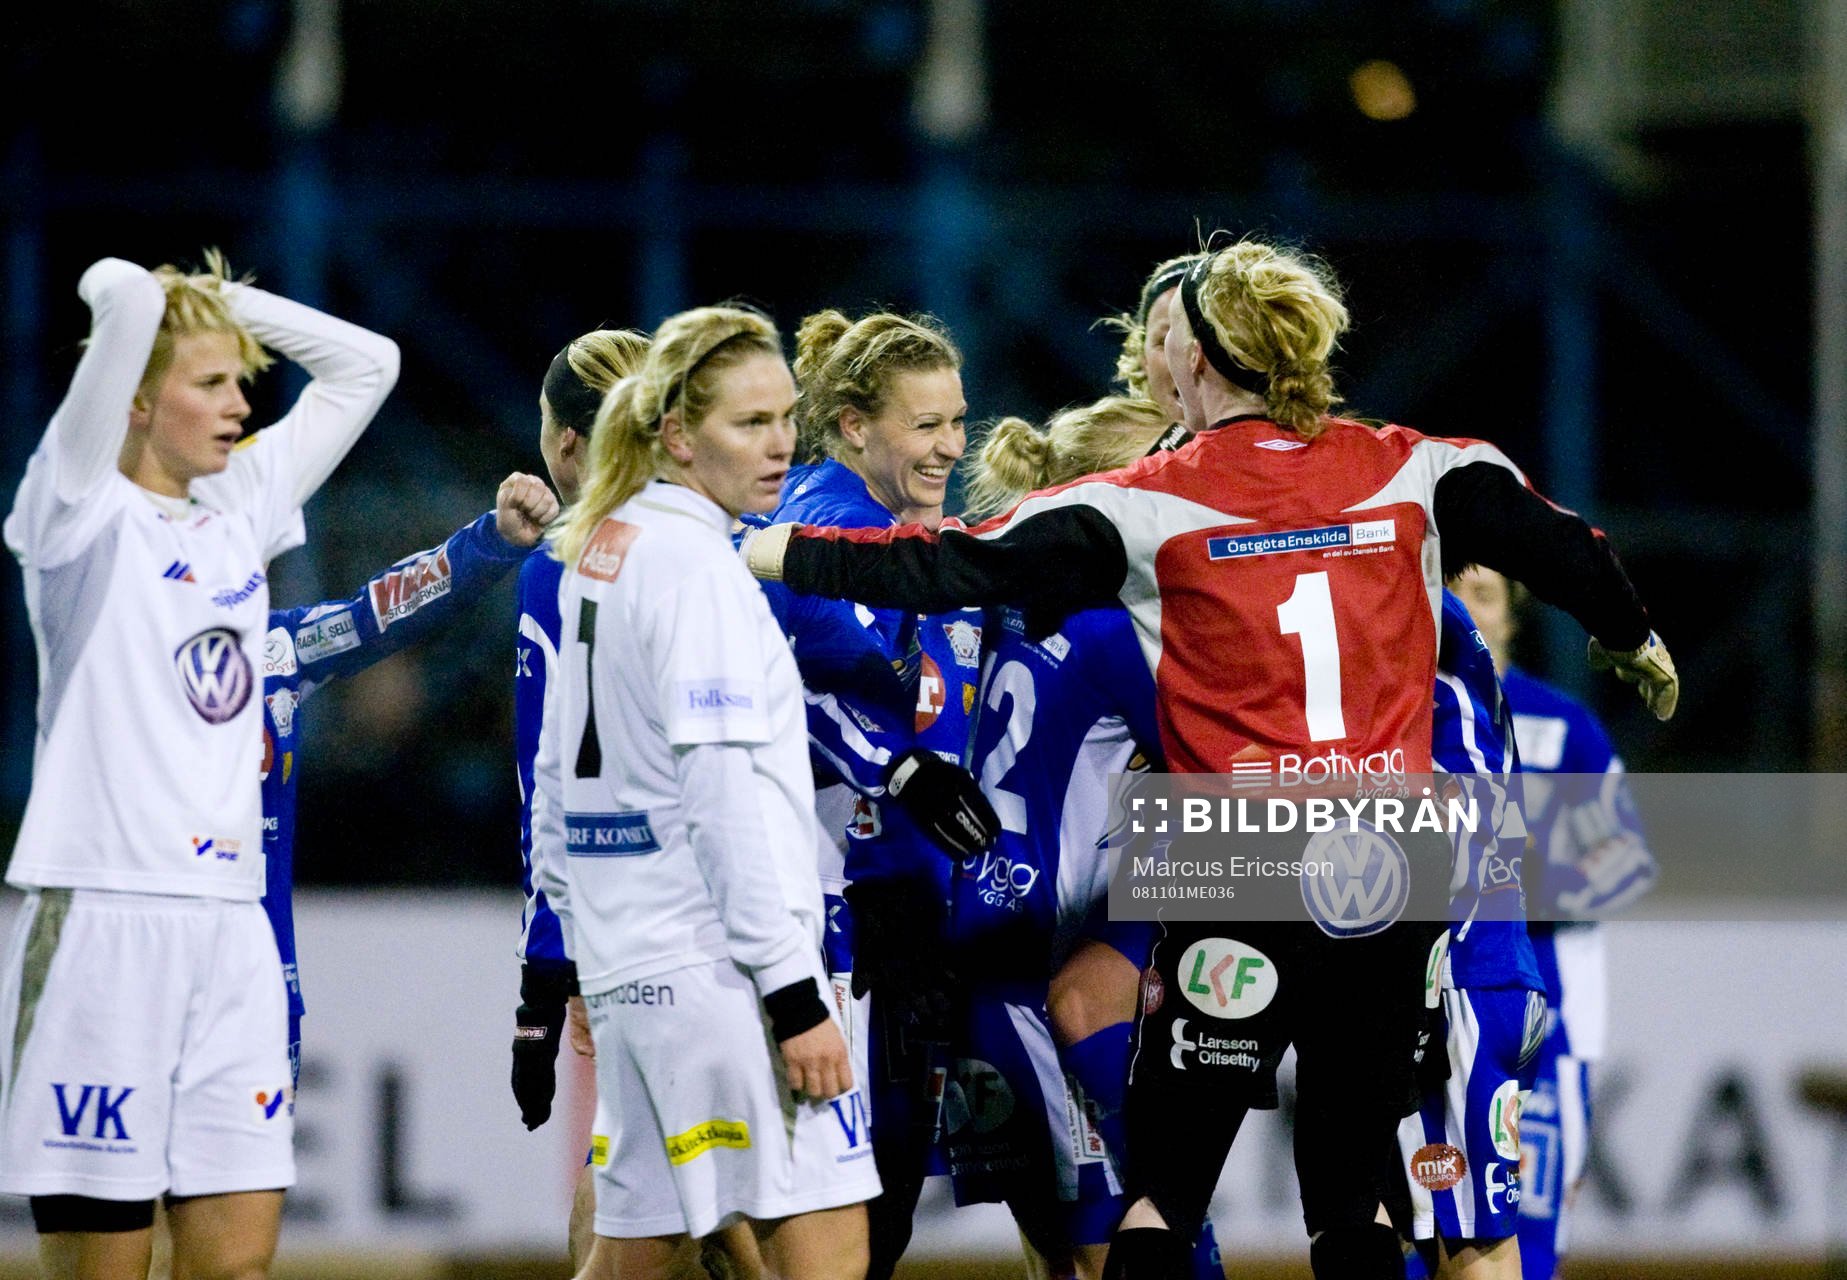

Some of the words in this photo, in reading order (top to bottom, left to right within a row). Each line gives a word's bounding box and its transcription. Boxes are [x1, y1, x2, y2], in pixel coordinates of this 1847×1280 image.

[1227, 531, 1347, 554] ÖstgötaEnskilda
[1356, 526, 1390, 539] Bank
[1046, 638, 1064, 655] ank
[1276, 571, 1346, 742] 1
[1187, 949, 1264, 1007] LKF
[1199, 1032, 1258, 1051] Larsson
[1199, 1050, 1260, 1072] Offsettry
[50, 1083, 136, 1140] VK
[1417, 1156, 1457, 1177] mix
